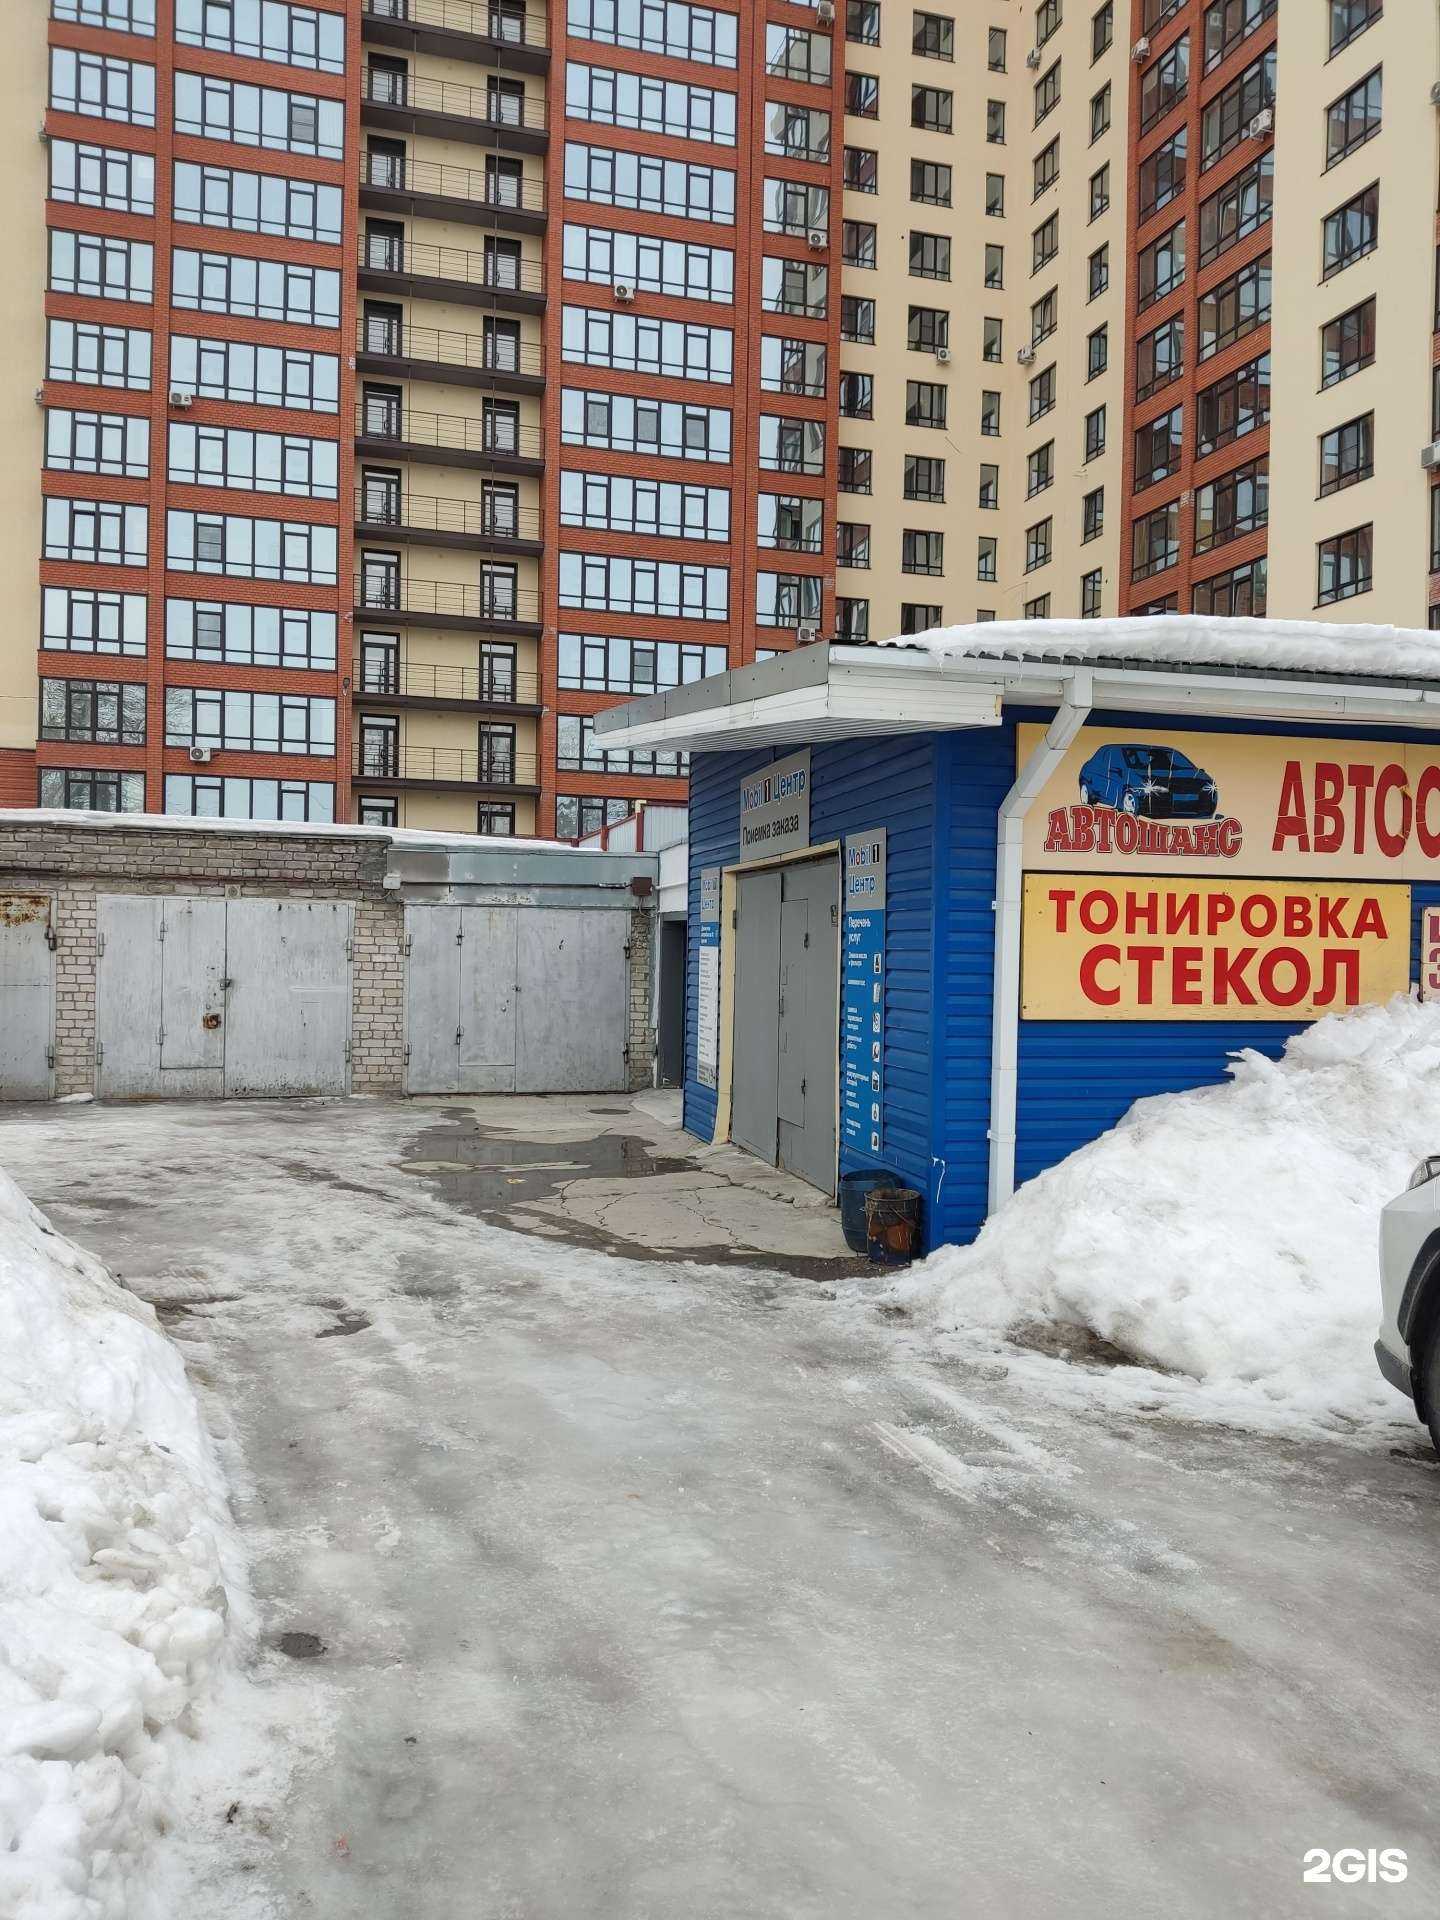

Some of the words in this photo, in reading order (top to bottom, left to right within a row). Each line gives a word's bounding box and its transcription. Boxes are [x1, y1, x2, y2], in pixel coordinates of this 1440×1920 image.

[743, 781, 764, 812] Mobil
[764, 778, 771, 804] 1
[772, 769, 806, 804] Центр
[743, 823, 770, 846] Приемка
[772, 814, 799, 837] заказа
[1044, 804, 1243, 858] АВТОШАНС
[849, 845, 871, 867] Mobil
[872, 843, 880, 864] 1
[849, 874, 875, 897] Центр
[1049, 889, 1389, 939] ТОНИРОВКА
[1079, 943, 1360, 1007] СТЕКОЛ
